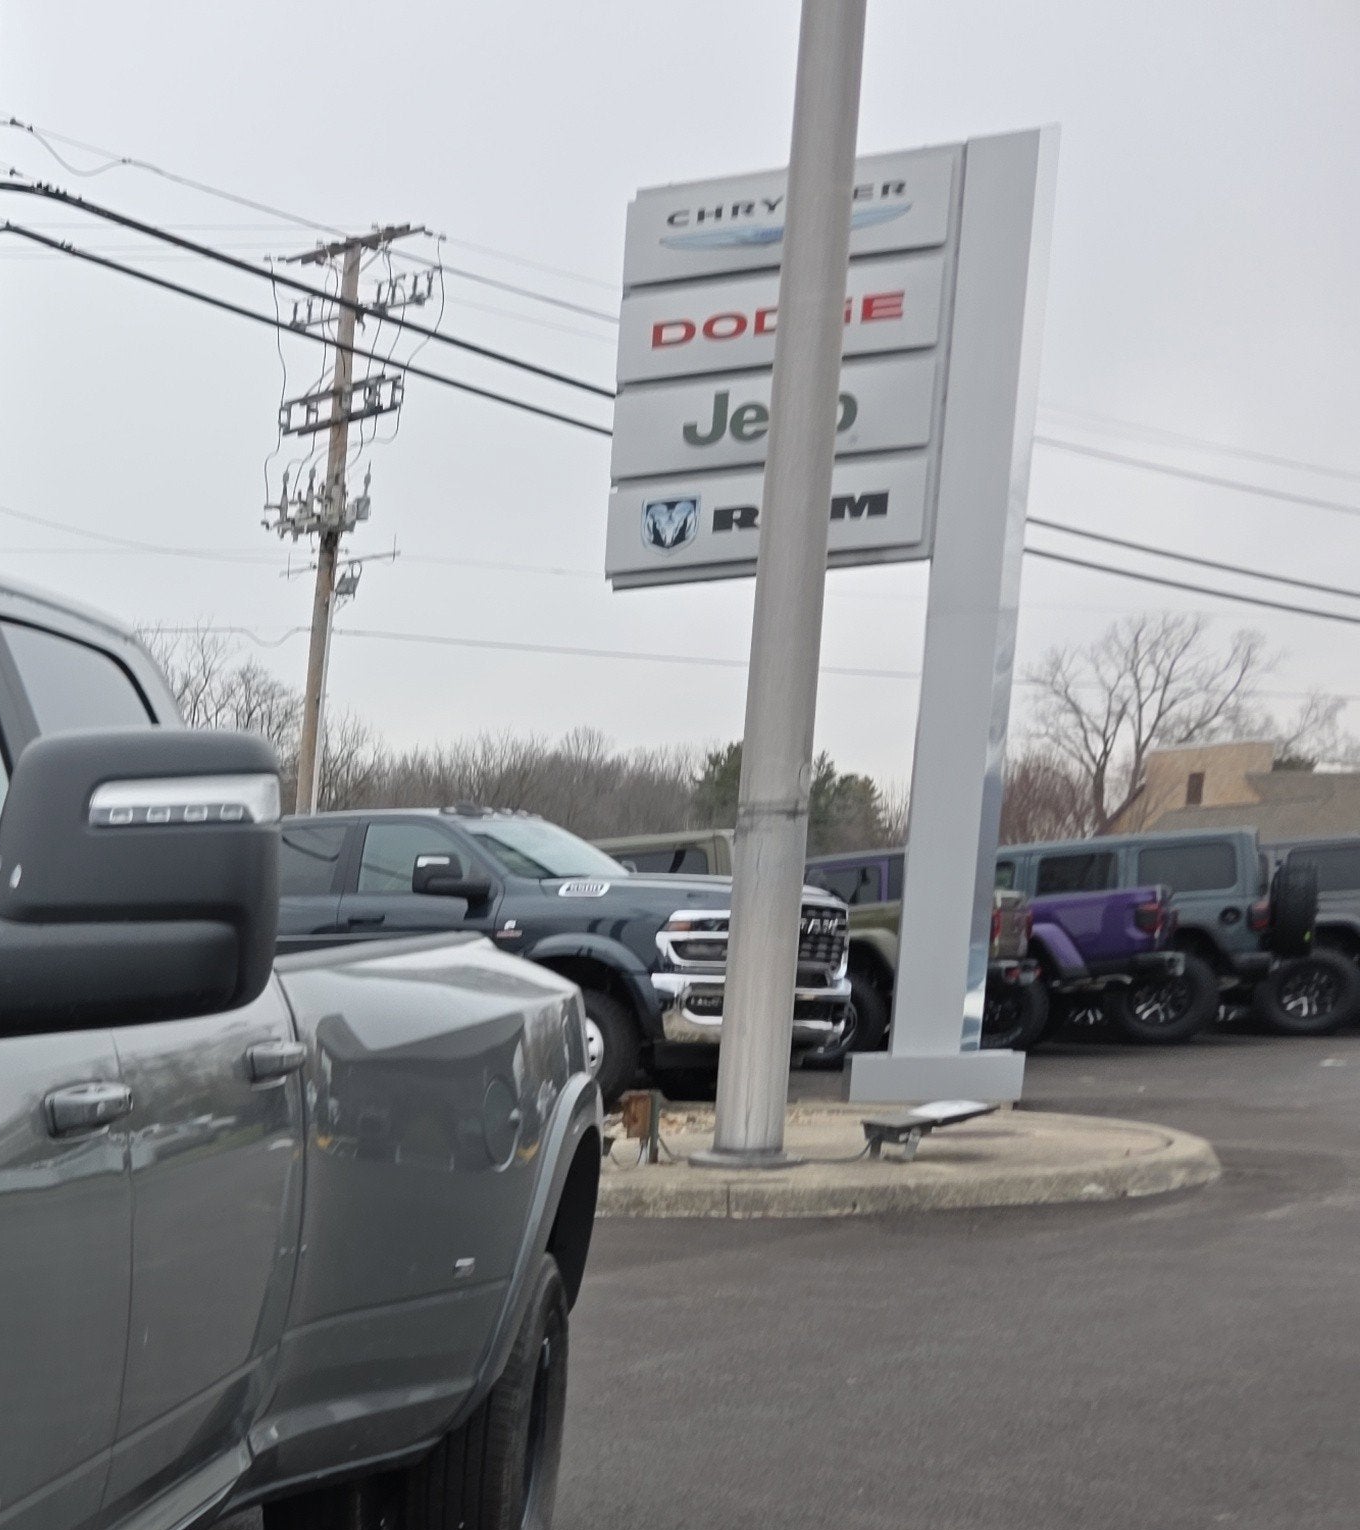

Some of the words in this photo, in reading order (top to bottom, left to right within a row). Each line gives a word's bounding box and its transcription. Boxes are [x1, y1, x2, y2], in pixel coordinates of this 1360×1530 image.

[666, 180, 906, 228] CHRYER
[651, 290, 905, 350] DODE
[682, 388, 858, 447] Je
[711, 488, 890, 534] RM
